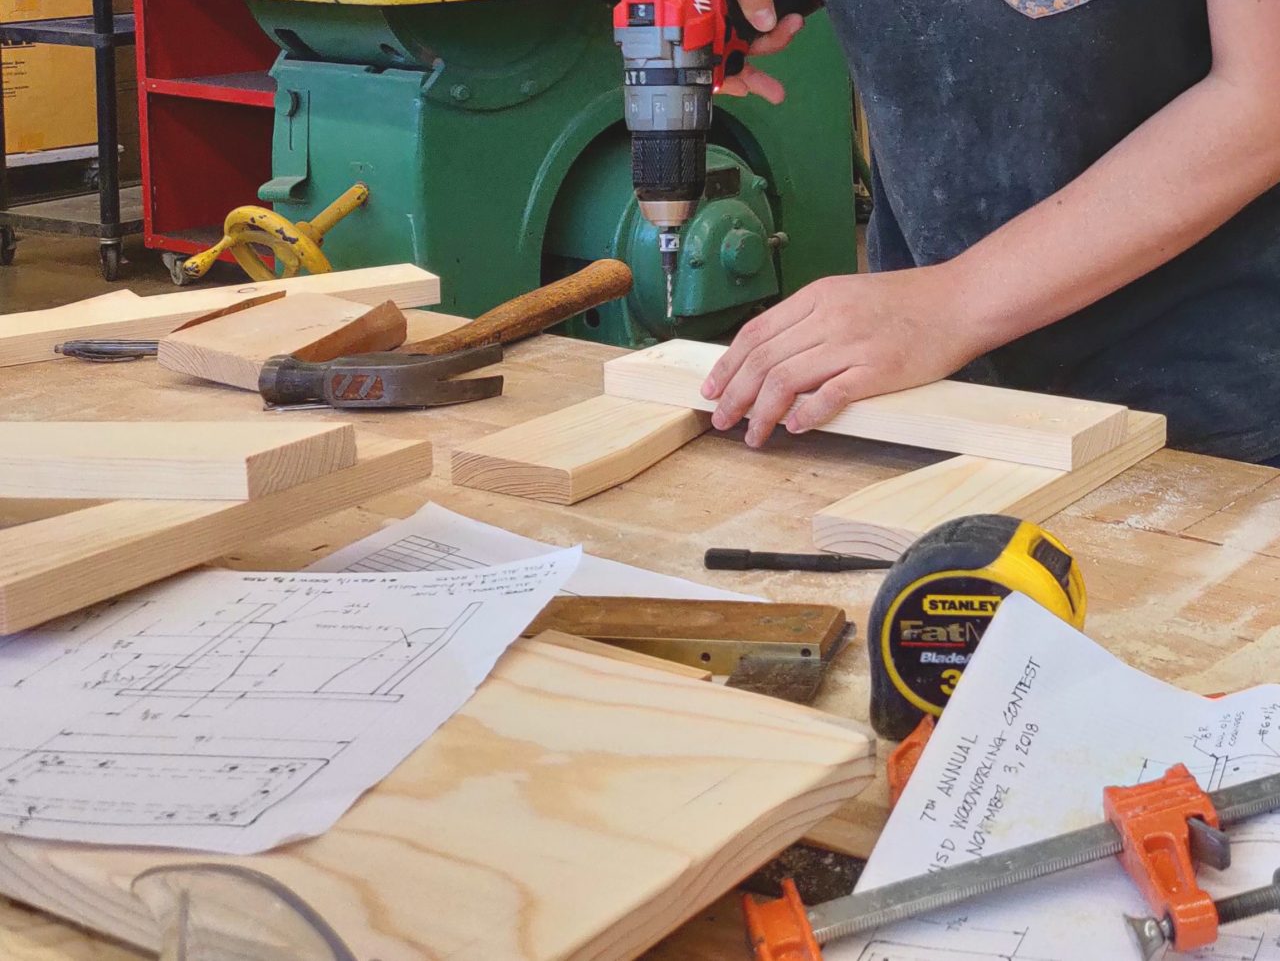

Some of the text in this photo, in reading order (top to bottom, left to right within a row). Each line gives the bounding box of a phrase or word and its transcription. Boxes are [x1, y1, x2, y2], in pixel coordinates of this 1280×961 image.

[928, 598, 1000, 612] STANLEY
[950, 730, 1008, 832] WOODWORKING
[1006, 656, 1042, 727] CONTEST
[1015, 722, 1040, 757] 2018
[937, 734, 979, 798] ANNUAL
